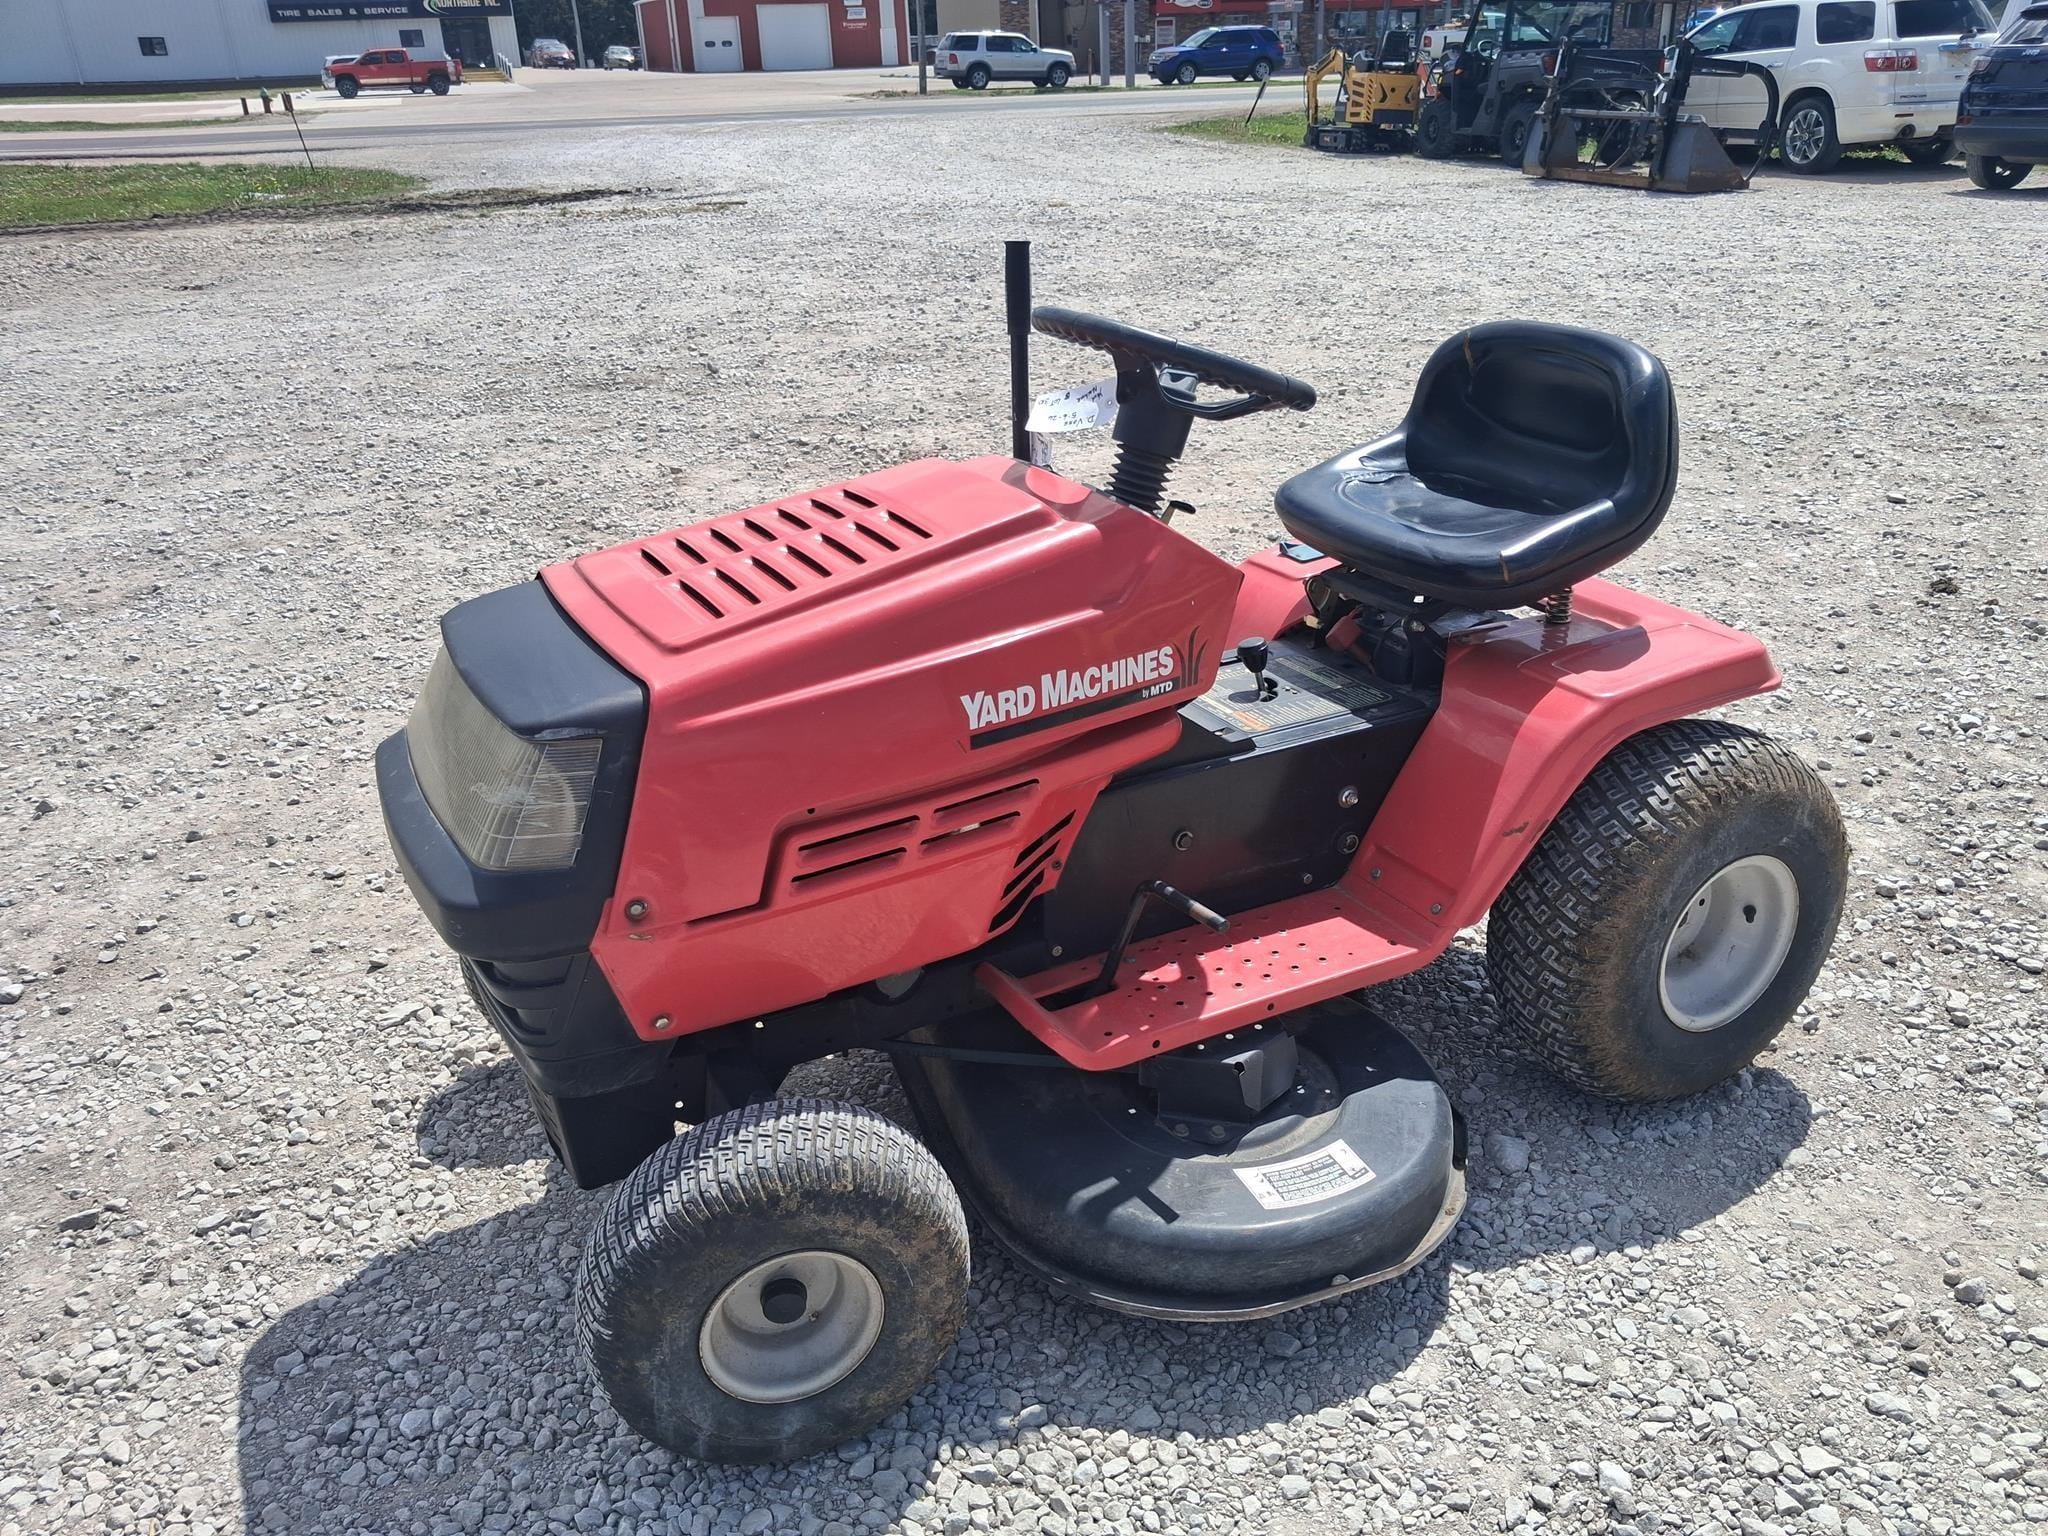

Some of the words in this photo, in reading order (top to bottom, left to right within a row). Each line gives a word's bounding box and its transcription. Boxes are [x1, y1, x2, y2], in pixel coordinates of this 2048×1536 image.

[277, 9, 301, 17] TIRE
[307, 8, 343, 17] SALES
[363, 6, 409, 15] SERVICE
[960, 685, 1036, 731] YARD
[1041, 645, 1175, 711] MACHINES
[1142, 688, 1150, 699] by
[1150, 681, 1174, 697] MTD
